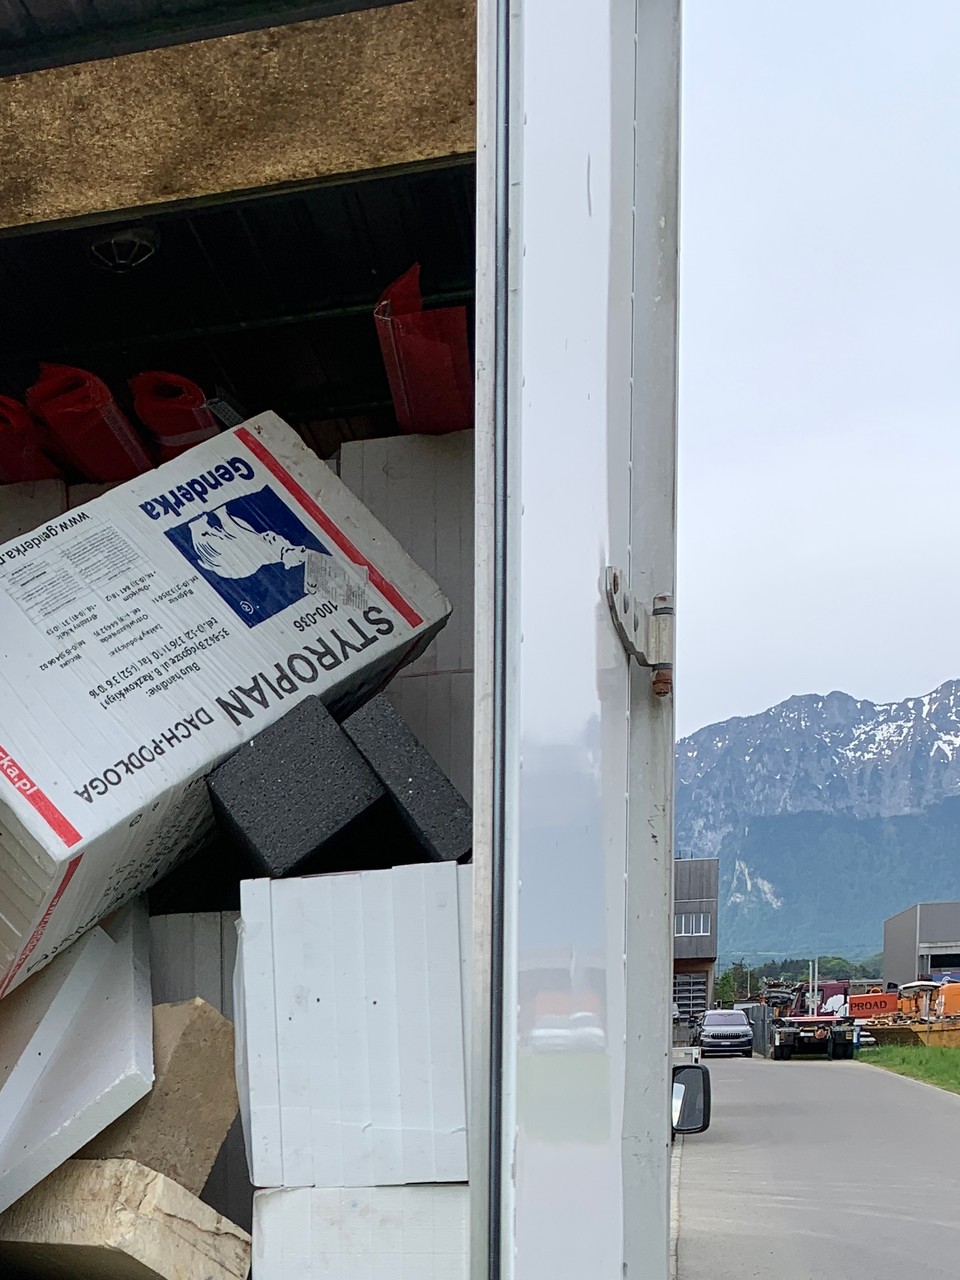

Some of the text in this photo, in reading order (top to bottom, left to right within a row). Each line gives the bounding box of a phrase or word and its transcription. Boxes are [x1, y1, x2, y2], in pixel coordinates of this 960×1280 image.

[138, 456, 255, 522] Genderka
[293, 600, 338, 631] 100-036
[73, 606, 394, 803] STYROPIAN DACH-PODŁOGA
